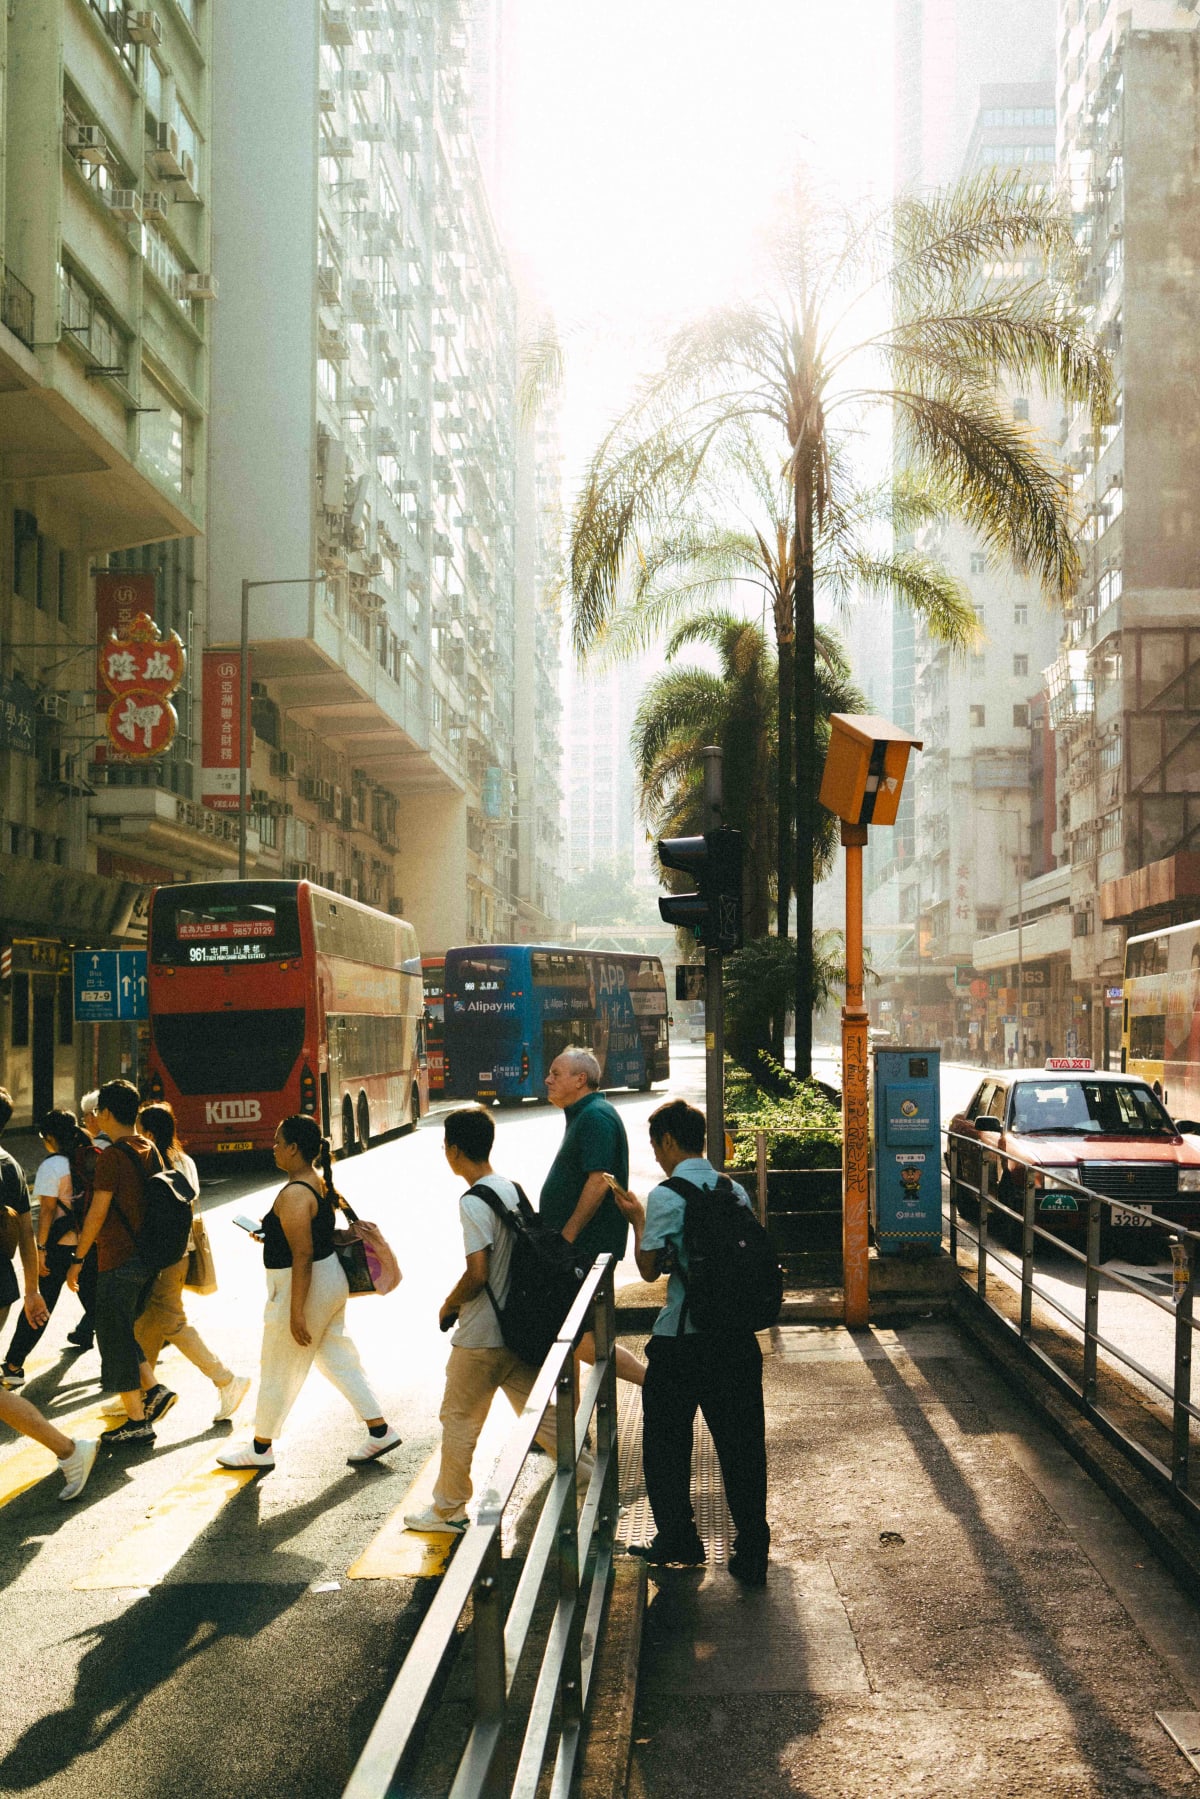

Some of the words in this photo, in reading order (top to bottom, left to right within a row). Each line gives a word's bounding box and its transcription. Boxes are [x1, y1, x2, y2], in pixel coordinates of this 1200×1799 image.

[117, 698, 164, 749] 押
[221, 681, 233, 760] 亞洲聯合財務
[253, 926, 273, 935] 0129
[189, 947, 206, 961] 961
[86, 978, 105, 988] 巴士
[599, 964, 625, 995] APP
[93, 992, 110, 1000] 7-9
[1050, 1059, 1090, 1069] TAXI
[205, 1099, 262, 1125] KMB
[1054, 1197, 1063, 1205] 4
